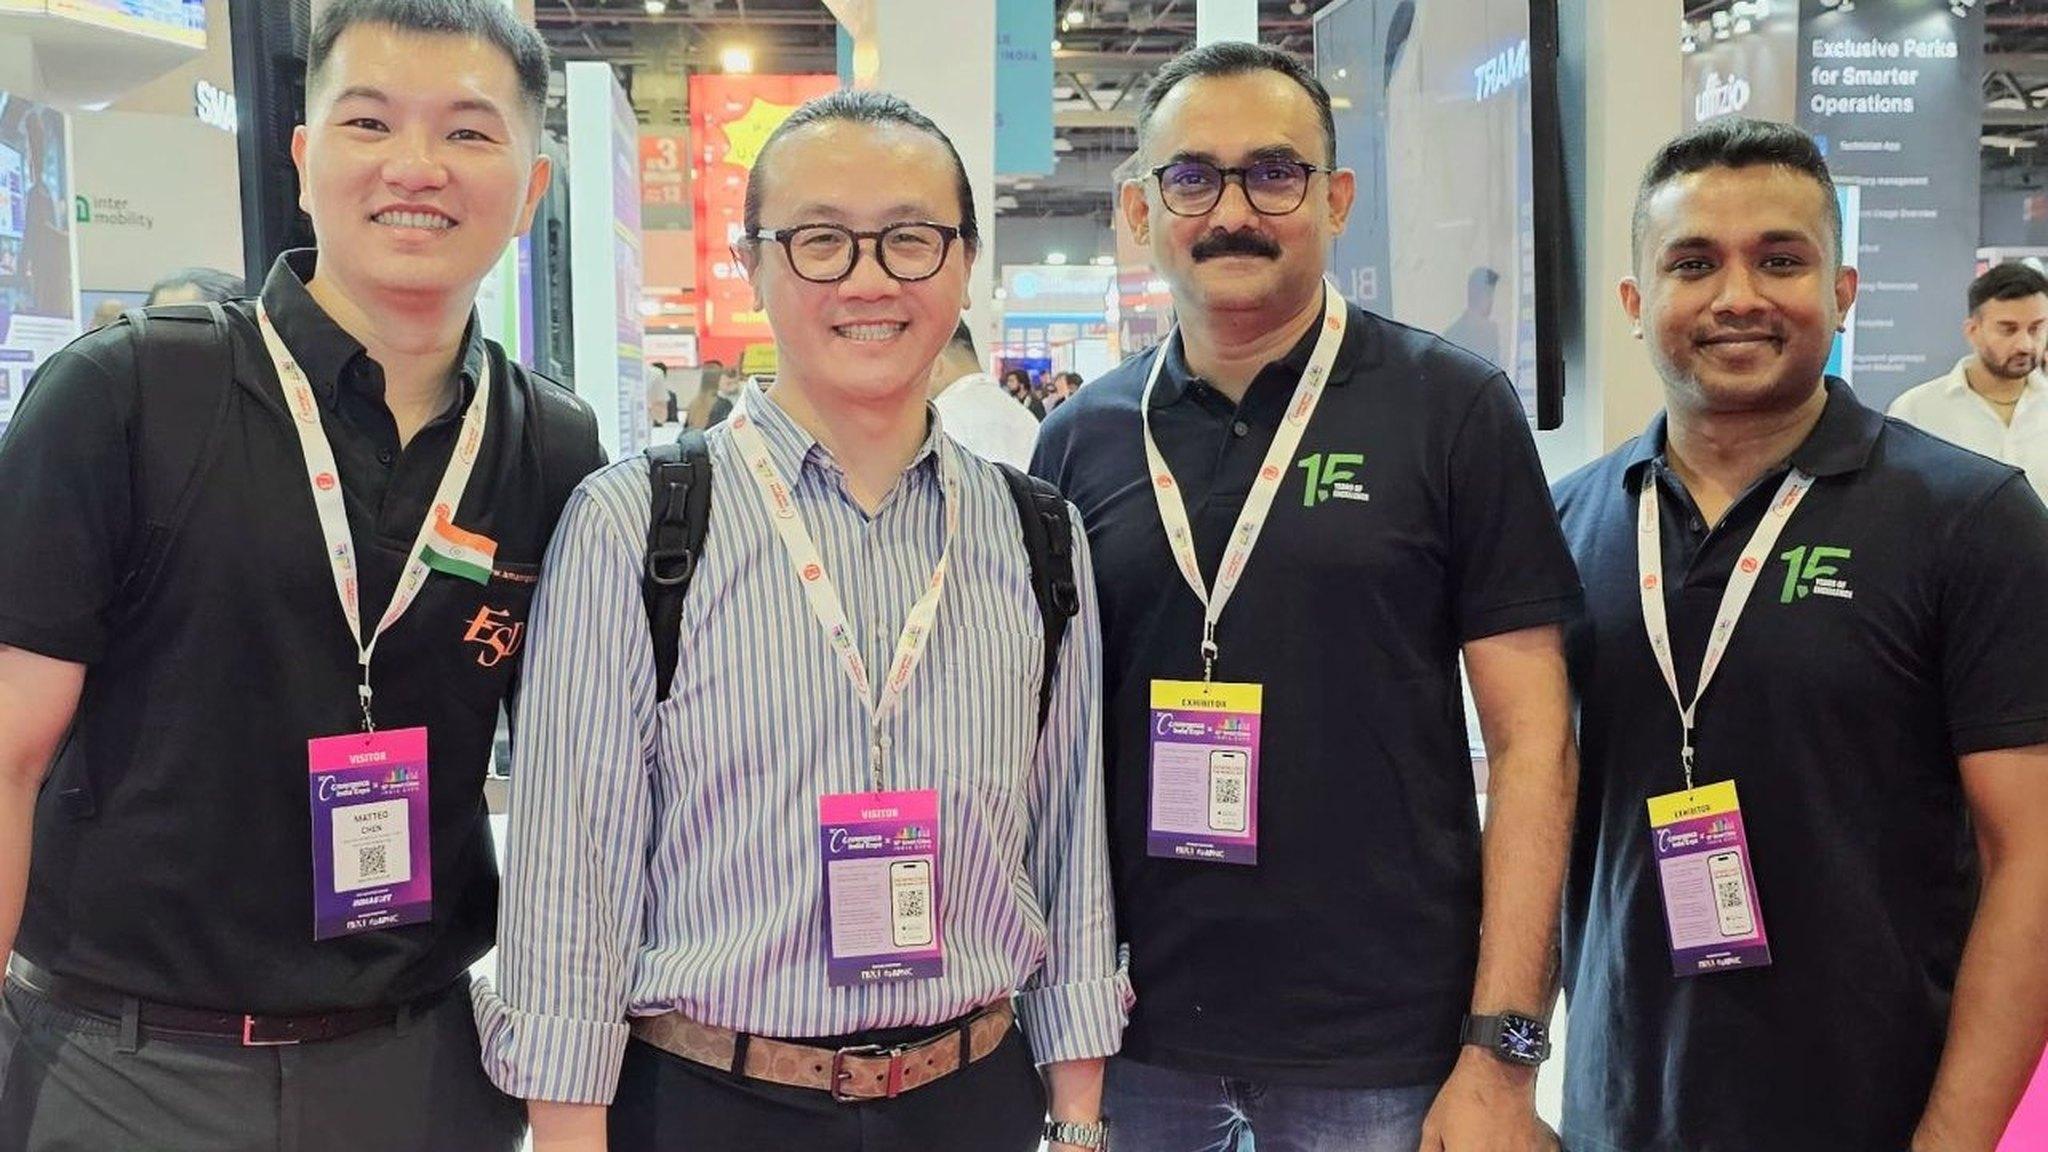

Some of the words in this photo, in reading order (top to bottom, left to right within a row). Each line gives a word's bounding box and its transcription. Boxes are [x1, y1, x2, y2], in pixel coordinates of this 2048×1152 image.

[1811, 38, 1899, 59] Exclusive
[1903, 39, 1959, 59] Perks
[1811, 66, 1837, 86] for
[1842, 66, 1920, 86] Smarter
[1811, 93, 1915, 117] Operations
[93, 196, 129, 209] inter
[93, 210, 154, 230] mobility
[349, 750, 387, 764] VISITOR
[354, 811, 389, 823] MATTEO
[861, 808, 899, 820] VISITOR
